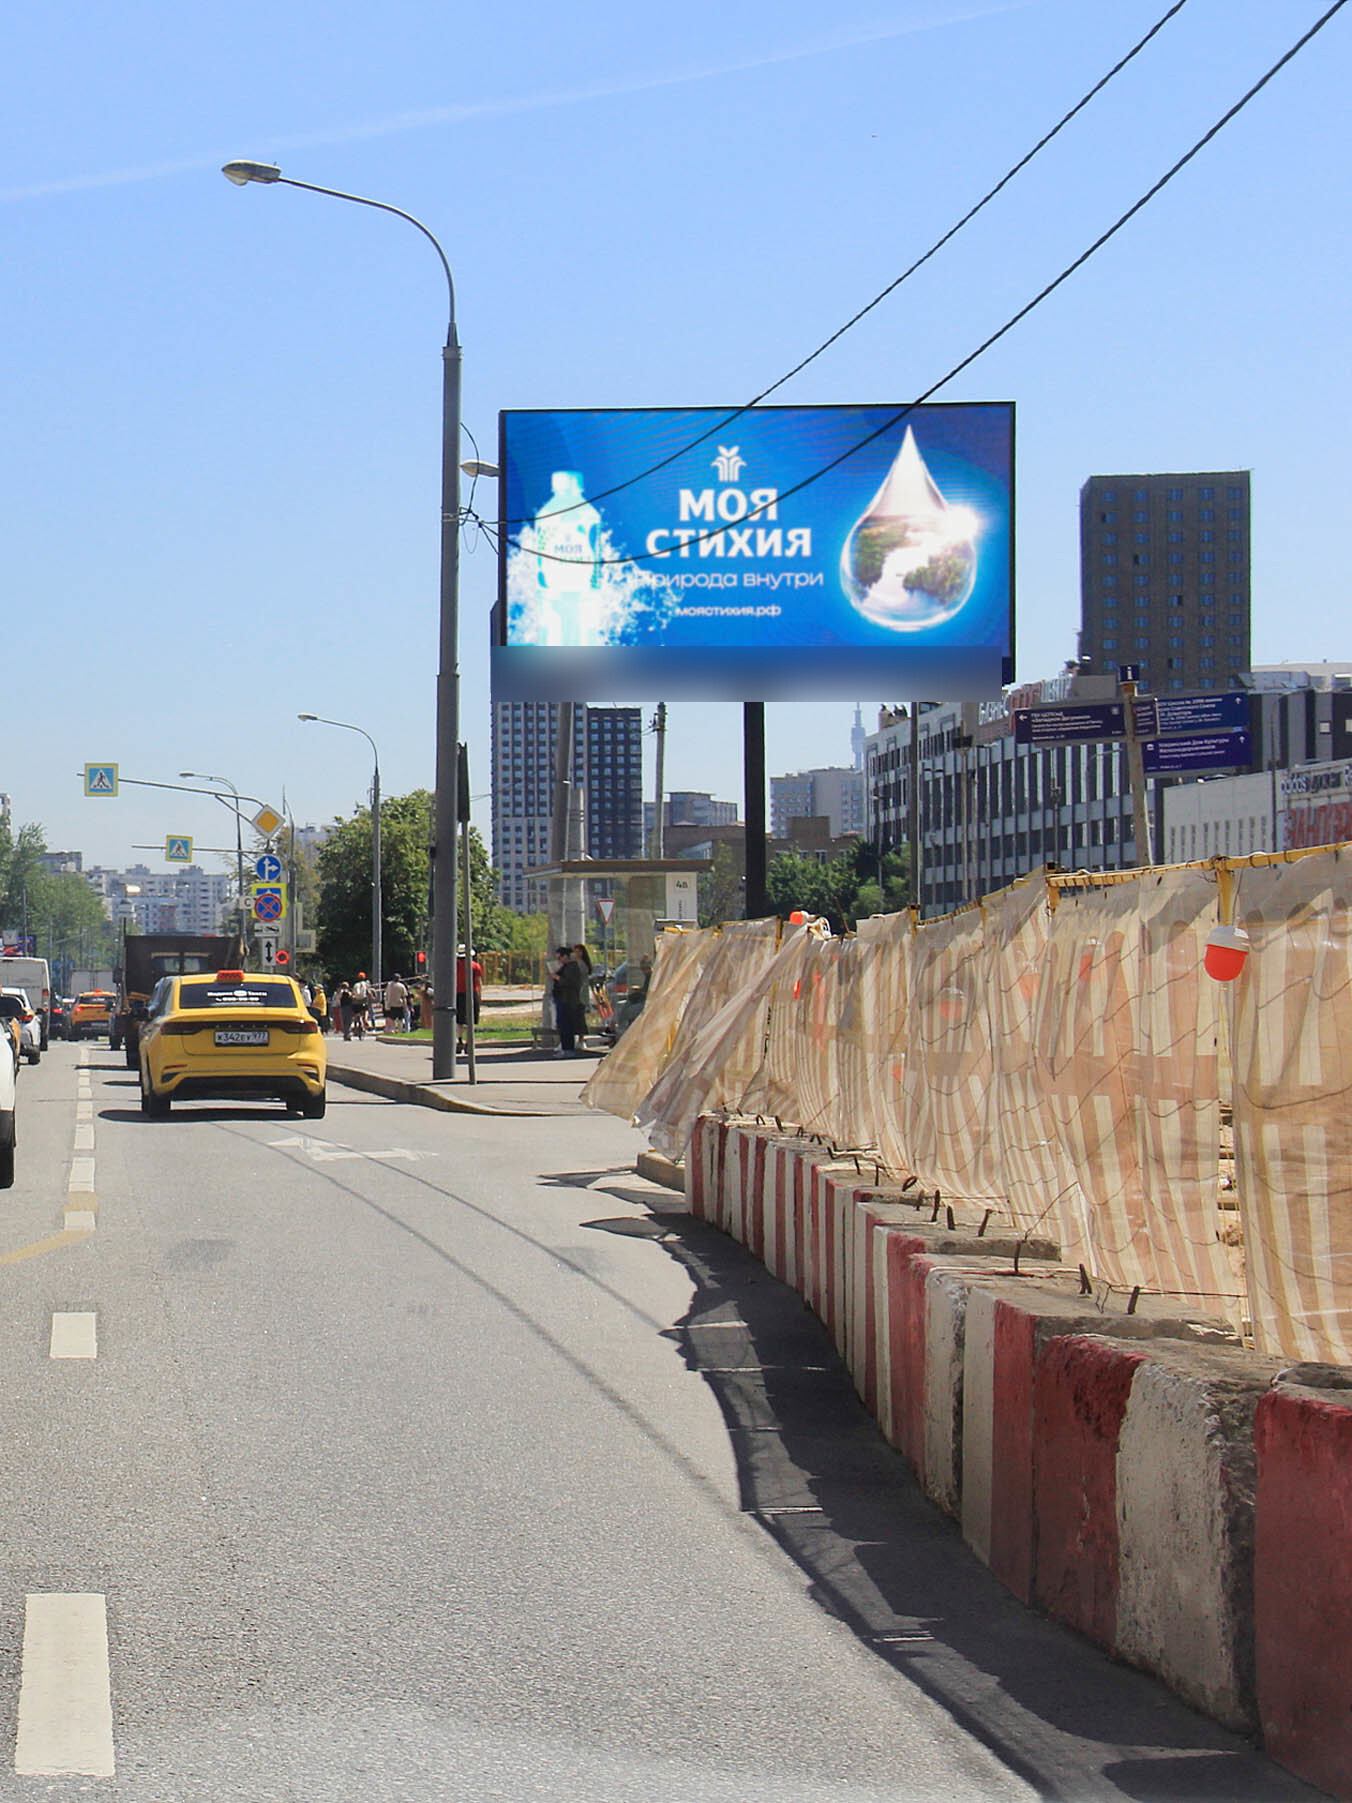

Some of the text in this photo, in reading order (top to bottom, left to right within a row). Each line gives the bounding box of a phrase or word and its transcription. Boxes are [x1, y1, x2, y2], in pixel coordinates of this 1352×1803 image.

[679, 488, 778, 521] МОЯ
[645, 528, 812, 558] СТИХИЯ
[743, 571, 824, 589] внутри
